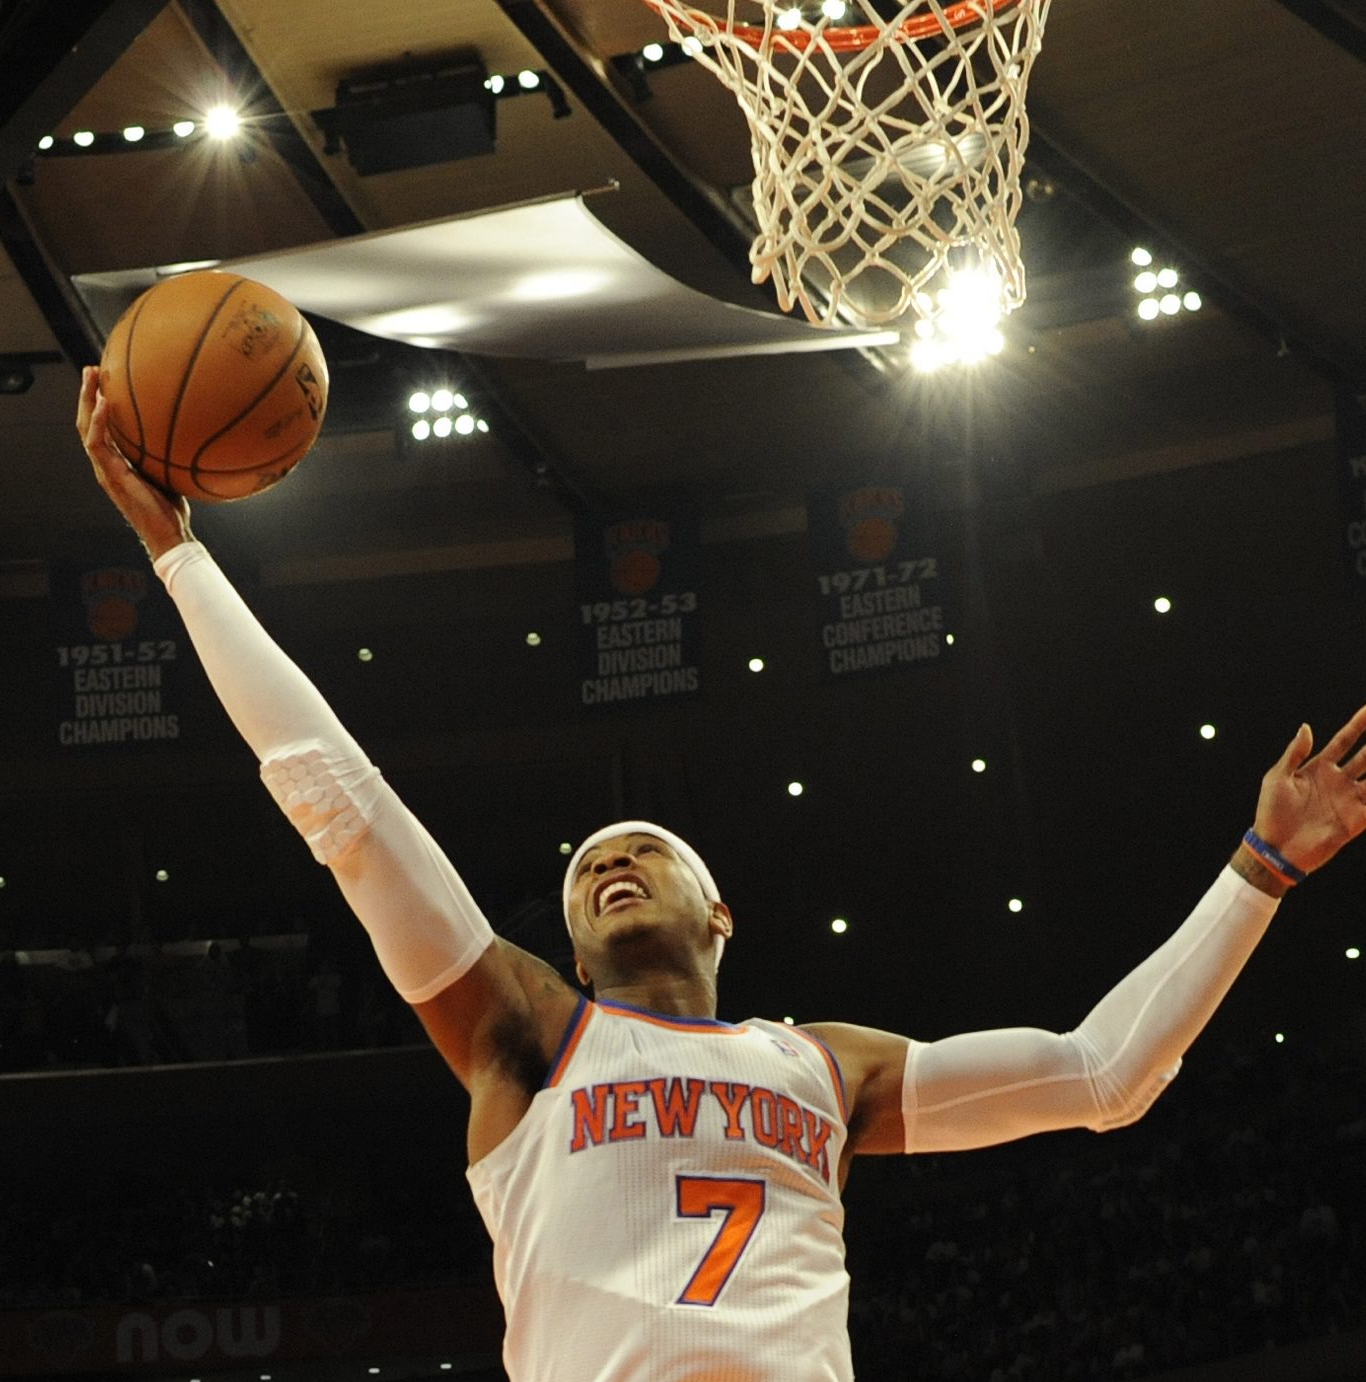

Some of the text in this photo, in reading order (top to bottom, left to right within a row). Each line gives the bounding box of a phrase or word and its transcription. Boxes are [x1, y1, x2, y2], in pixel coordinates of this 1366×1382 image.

[581, 592, 697, 624] 1952-53
[840, 585, 921, 620] EASTERN
[597, 618, 682, 650] EASTERN
[822, 606, 943, 648] CONFERENCE
[56, 640, 177, 667] 1951-52
[598, 643, 681, 676] DIVISION
[830, 632, 940, 674] CHAMPIONS
[74, 665, 162, 692] EASTERN
[582, 667, 699, 705] CHAMPIONS
[75, 691, 162, 718] DIVISION
[59, 715, 180, 746] CHAMPIONS
[570, 1077, 833, 1186] NEW YORK
[675, 1175, 766, 1307] 7
